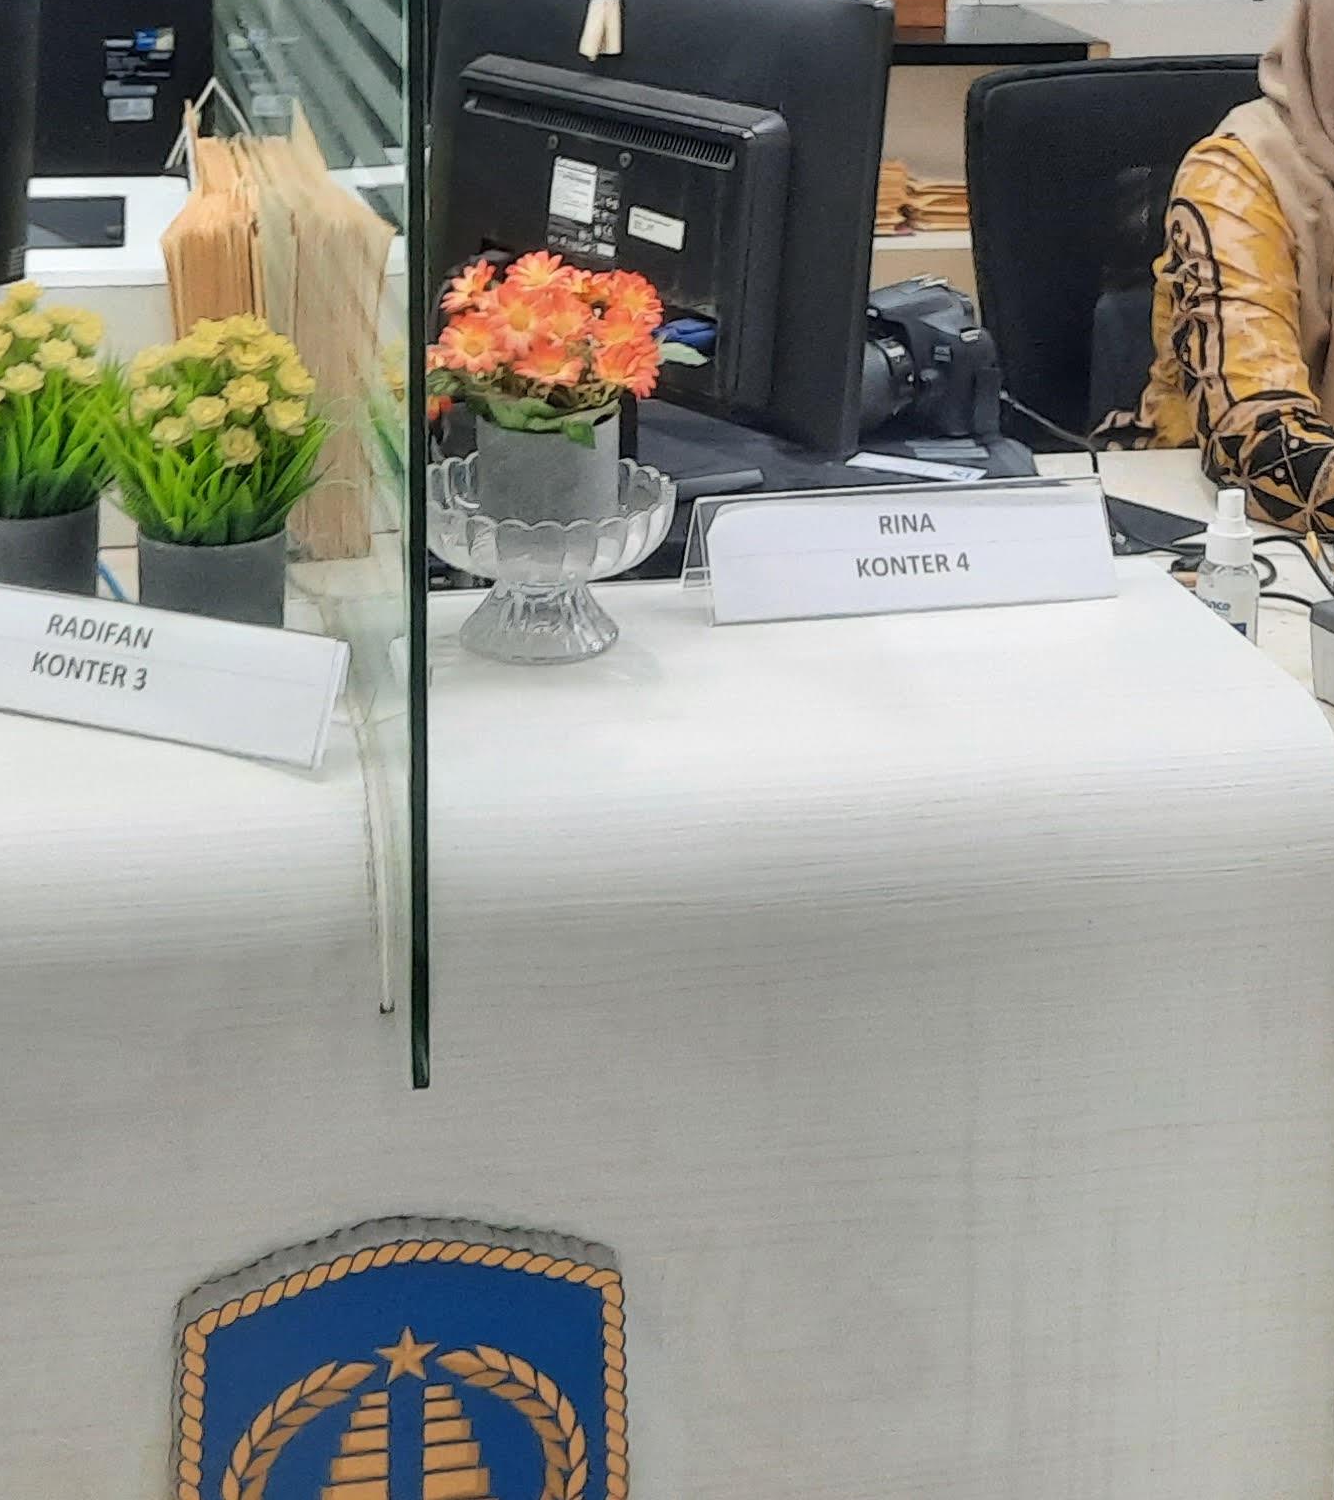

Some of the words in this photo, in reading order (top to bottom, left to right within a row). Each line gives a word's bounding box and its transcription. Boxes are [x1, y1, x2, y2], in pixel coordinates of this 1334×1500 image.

[878, 512, 936, 535] RINA
[856, 552, 951, 579] KONTER
[956, 551, 971, 572] 4
[45, 613, 154, 650] RADIFAN
[30, 650, 127, 689] KONTER
[132, 666, 149, 692] 3
